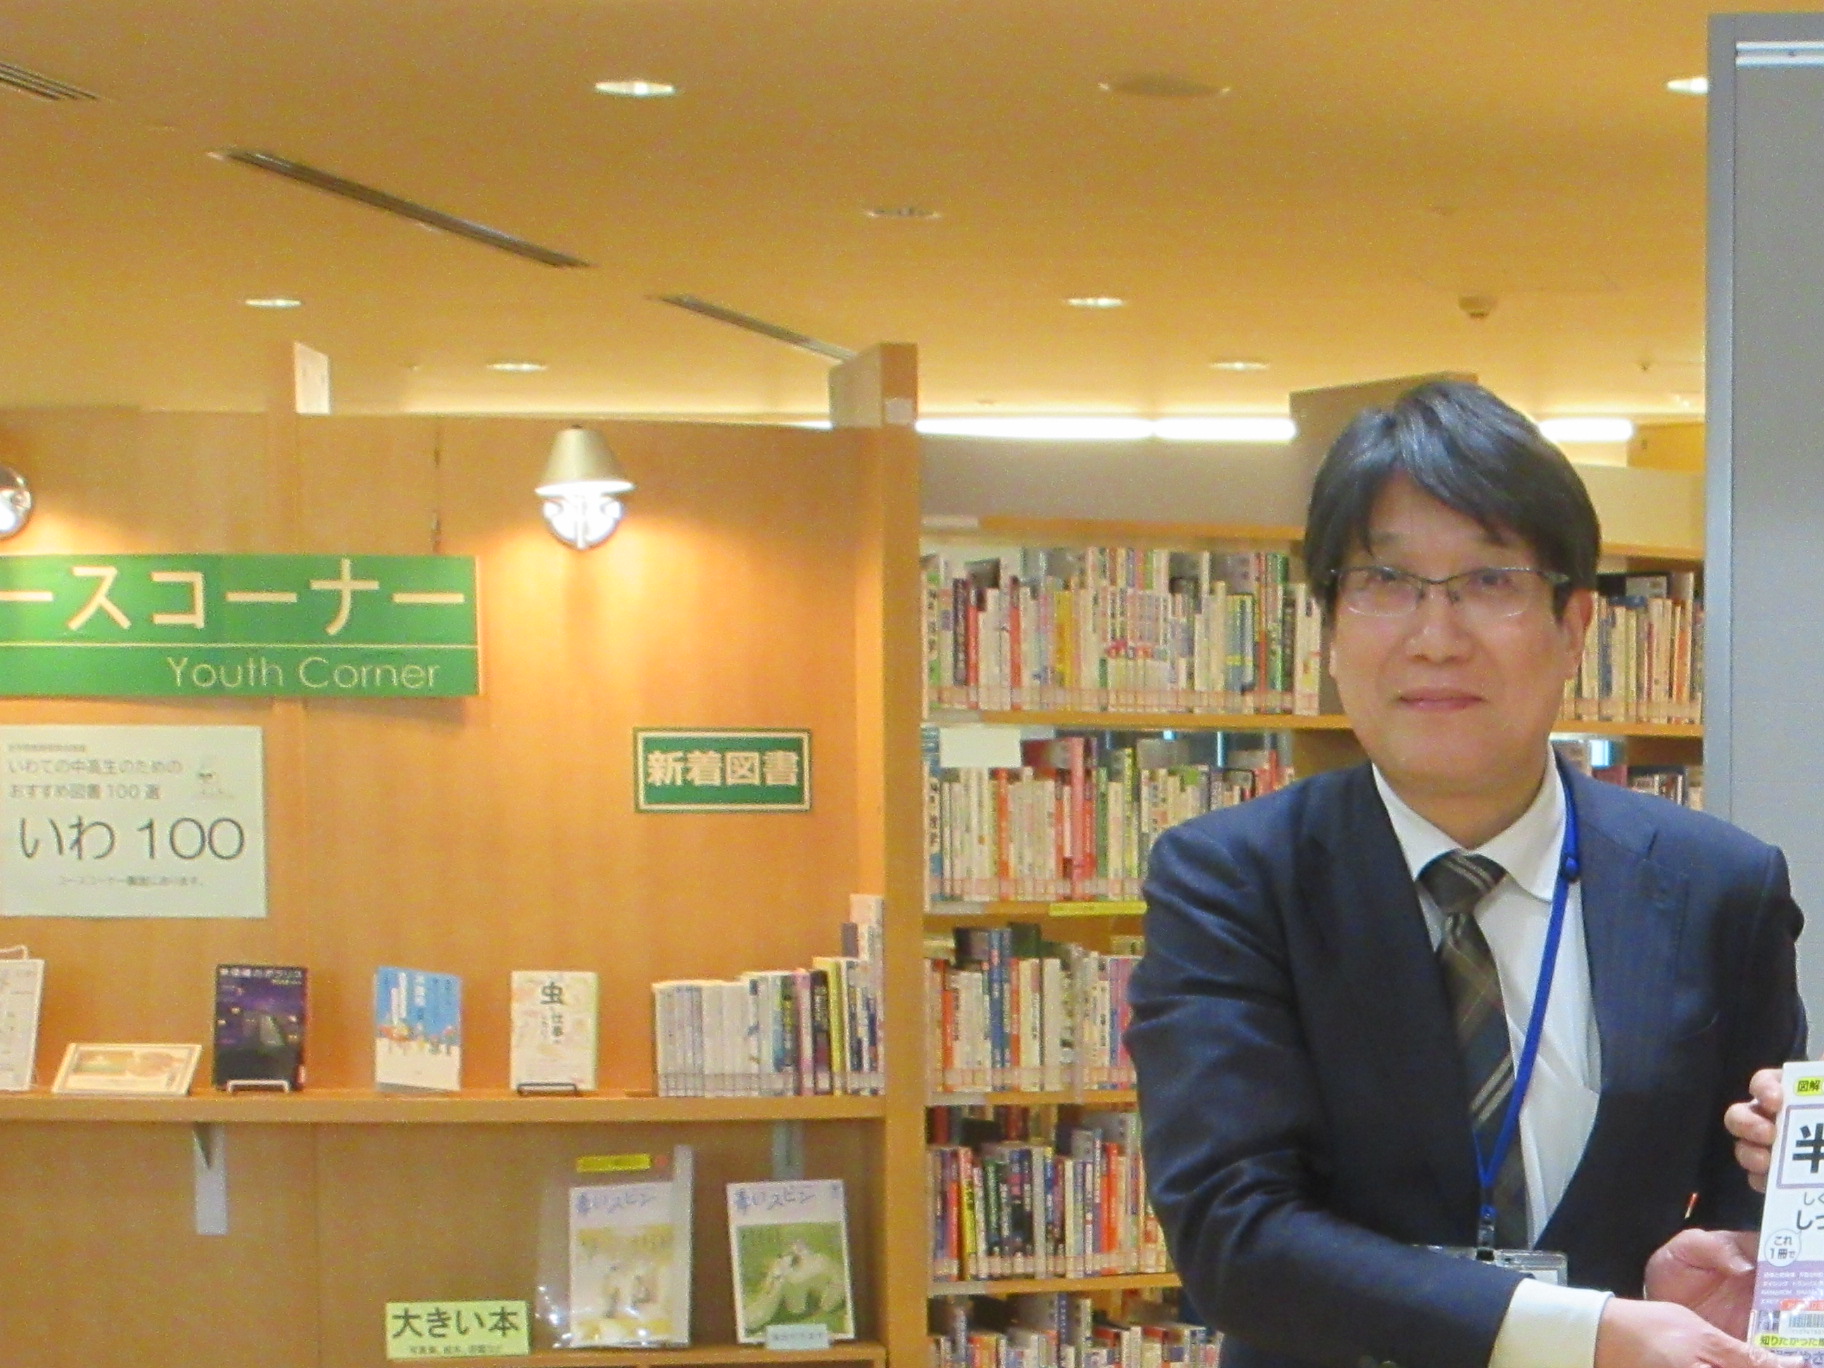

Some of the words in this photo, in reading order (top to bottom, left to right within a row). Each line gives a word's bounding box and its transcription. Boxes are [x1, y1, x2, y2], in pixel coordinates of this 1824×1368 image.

[0, 558, 466, 636] ースコーナー
[167, 656, 284, 688] Youth
[299, 656, 441, 689] Corner
[645, 750, 801, 787] 新着図書
[20, 815, 115, 860] いわ
[137, 817, 245, 860] 100
[1769, 1247, 1796, 1260] 1冊で
[1774, 1235, 1793, 1246] これ
[392, 1306, 520, 1339] 大きい本
